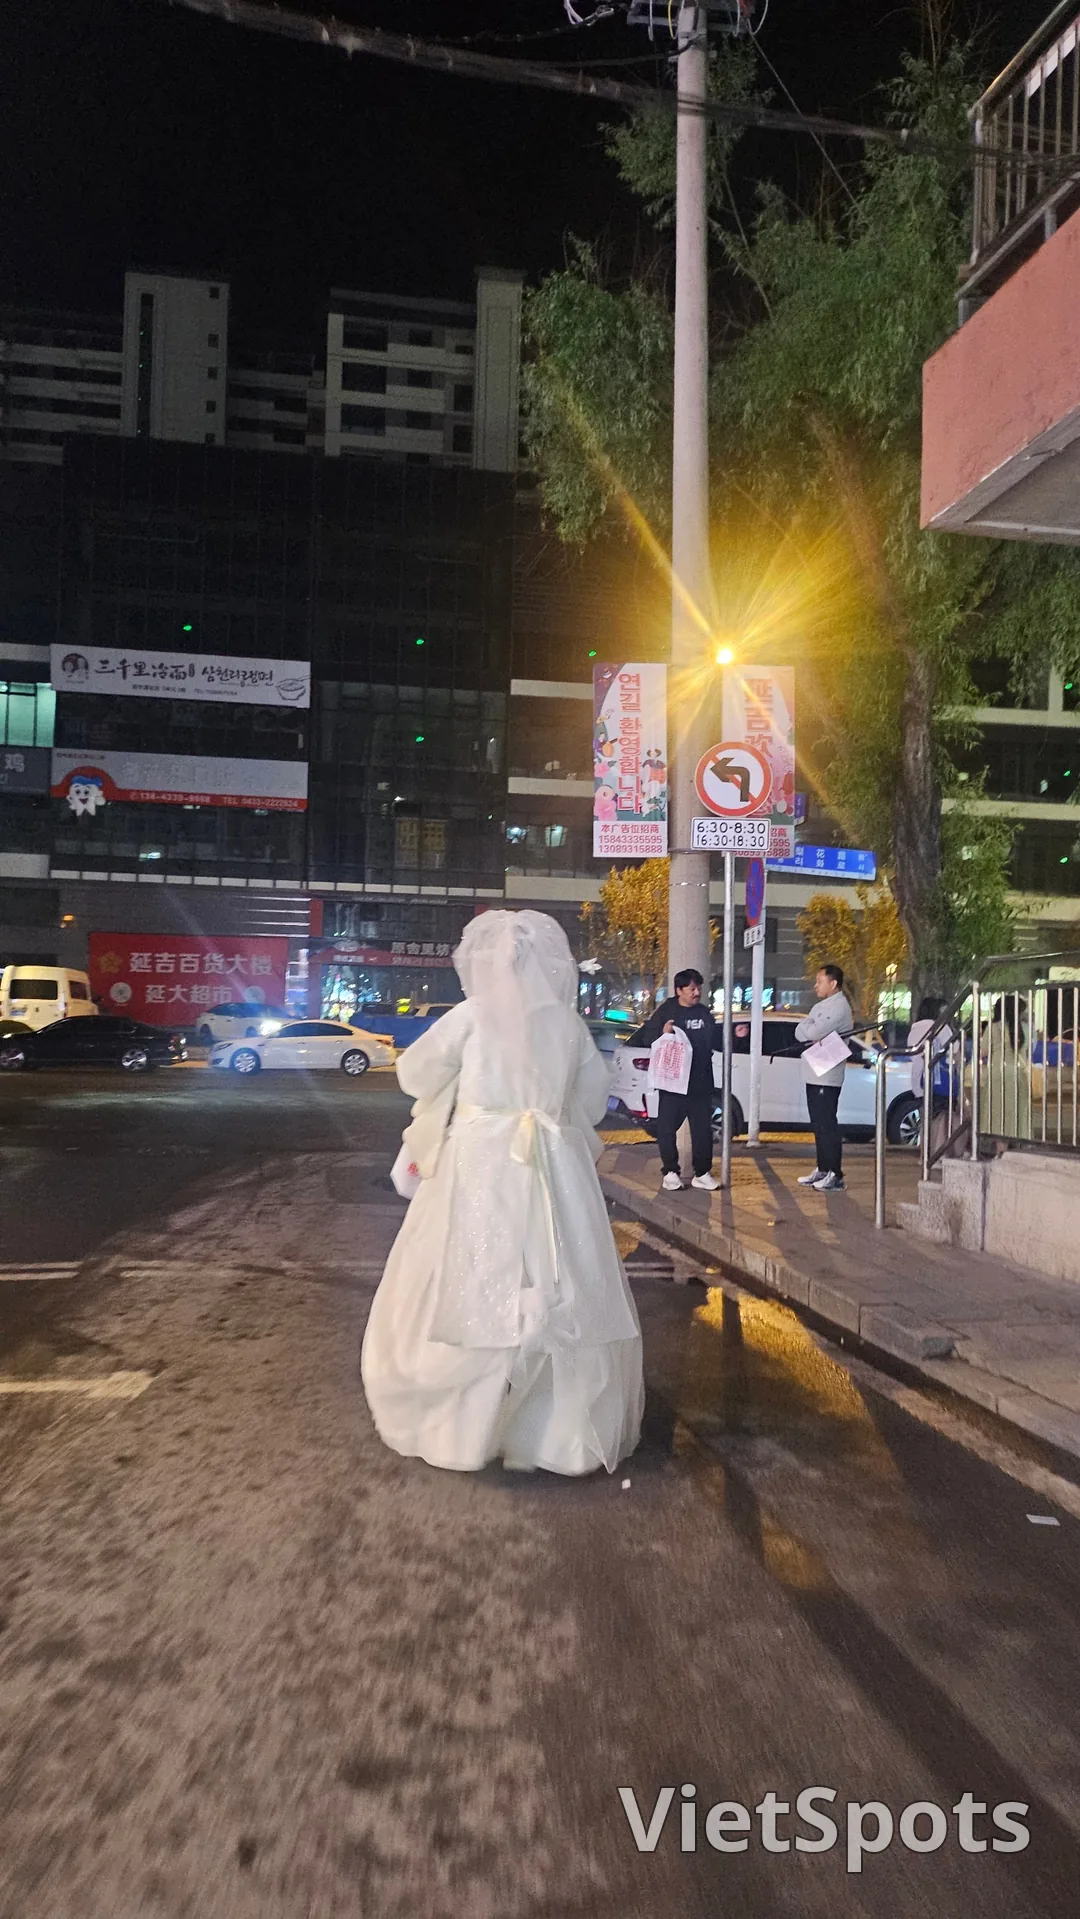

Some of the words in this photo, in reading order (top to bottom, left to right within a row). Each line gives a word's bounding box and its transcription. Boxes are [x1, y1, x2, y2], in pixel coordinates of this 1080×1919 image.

[95, 658, 187, 681] 三千里冷面
[618, 673, 641, 712] 연길
[617, 717, 642, 814] 환영합니다
[601, 824, 660, 834] 本广告位招商
[697, 822, 766, 834] 6:30-8:30
[598, 835, 662, 844] 15843335595
[697, 834, 765, 847] 16:30-18:30
[129, 952, 273, 976] 延吉百货大楼
[145, 984, 233, 1004] 延大超市
